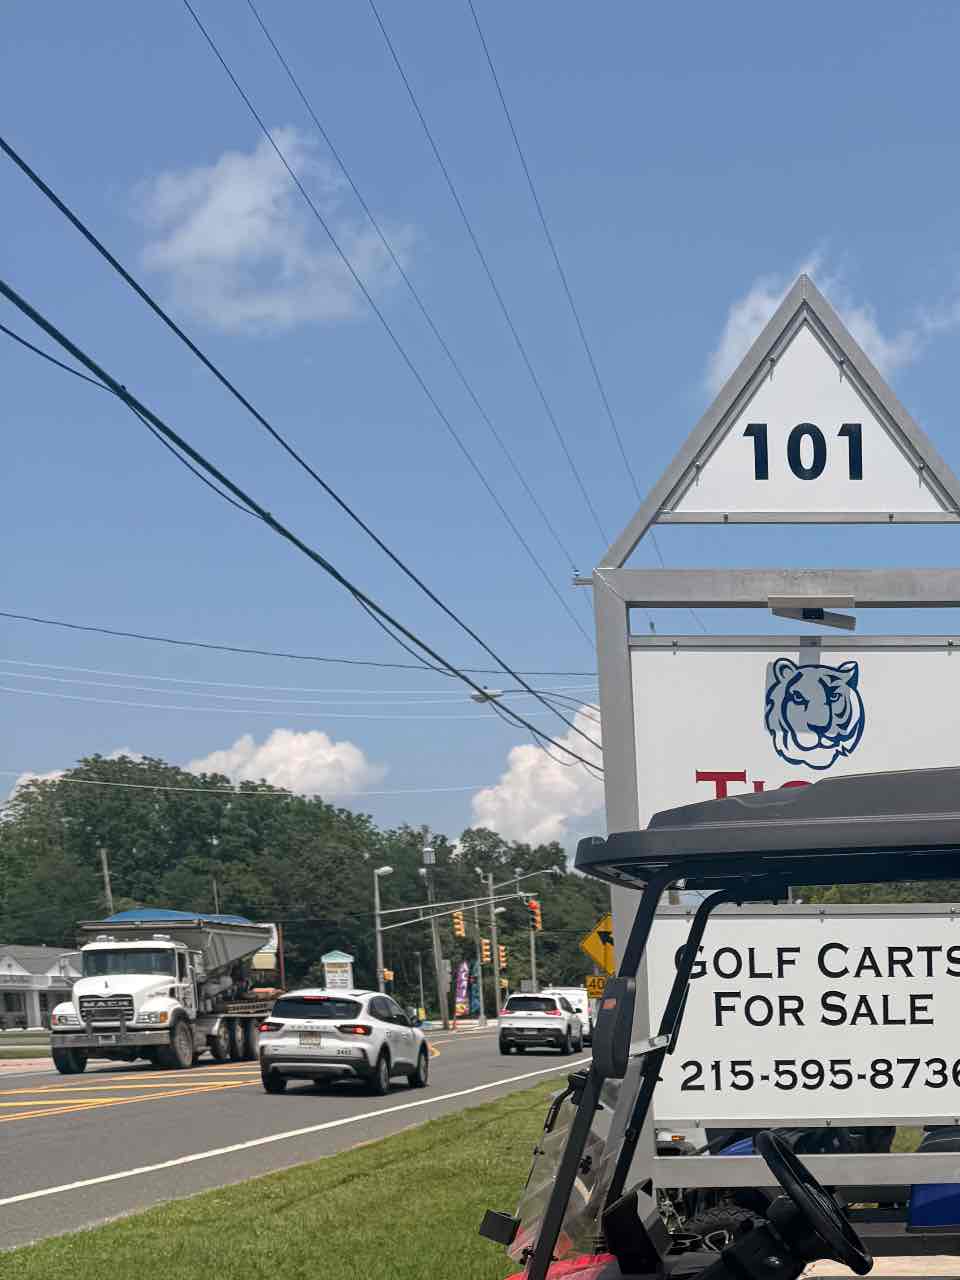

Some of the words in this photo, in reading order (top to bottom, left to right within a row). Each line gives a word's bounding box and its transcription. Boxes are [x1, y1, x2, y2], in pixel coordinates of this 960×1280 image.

[743, 423, 863, 481] 101
[674, 943, 801, 980] GOLF
[712, 991, 805, 1027] FOR
[820, 990, 934, 1027] SALE
